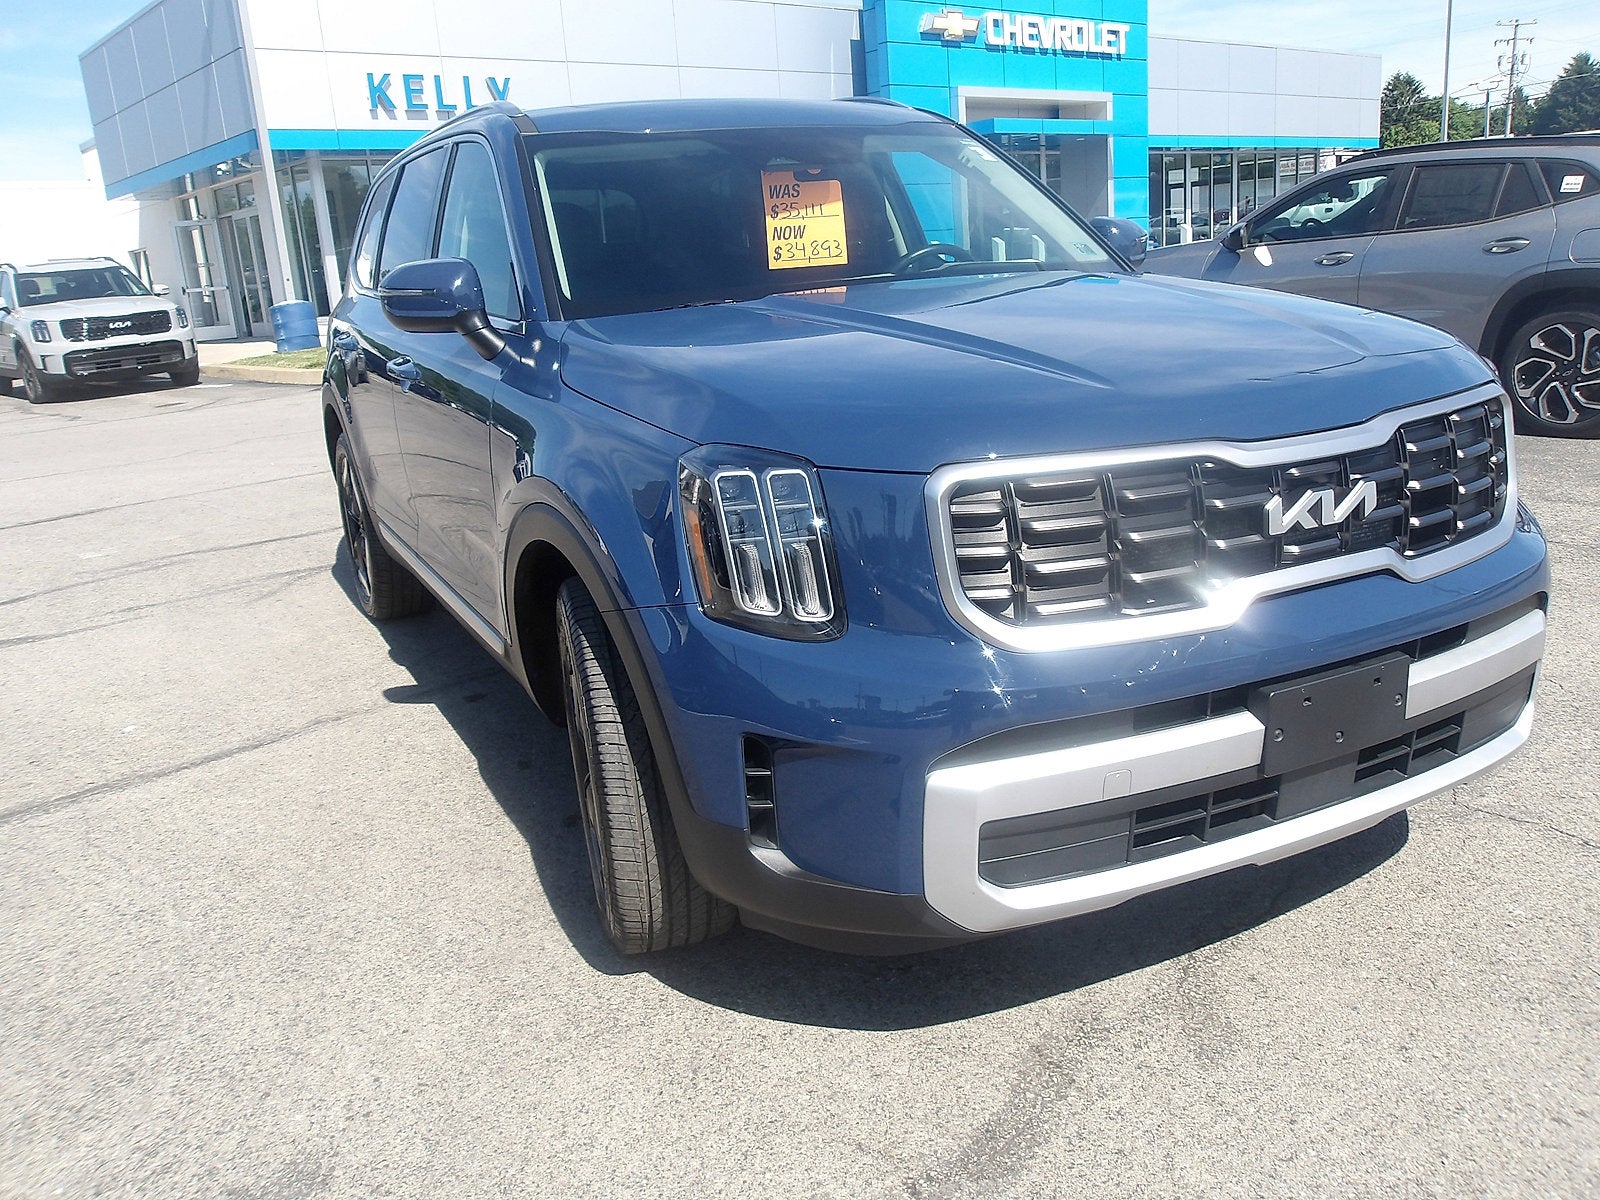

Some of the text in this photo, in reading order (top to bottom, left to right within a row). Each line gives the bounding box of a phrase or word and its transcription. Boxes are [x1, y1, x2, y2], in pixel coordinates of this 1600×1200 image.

[985, 12, 1130, 54] CHEVROLET
[366, 73, 511, 110] KELLY
[769, 184, 801, 199] WAS
[770, 202, 825, 220] $35,111
[772, 225, 807, 241] NOW
[773, 240, 843, 262] $34,893
